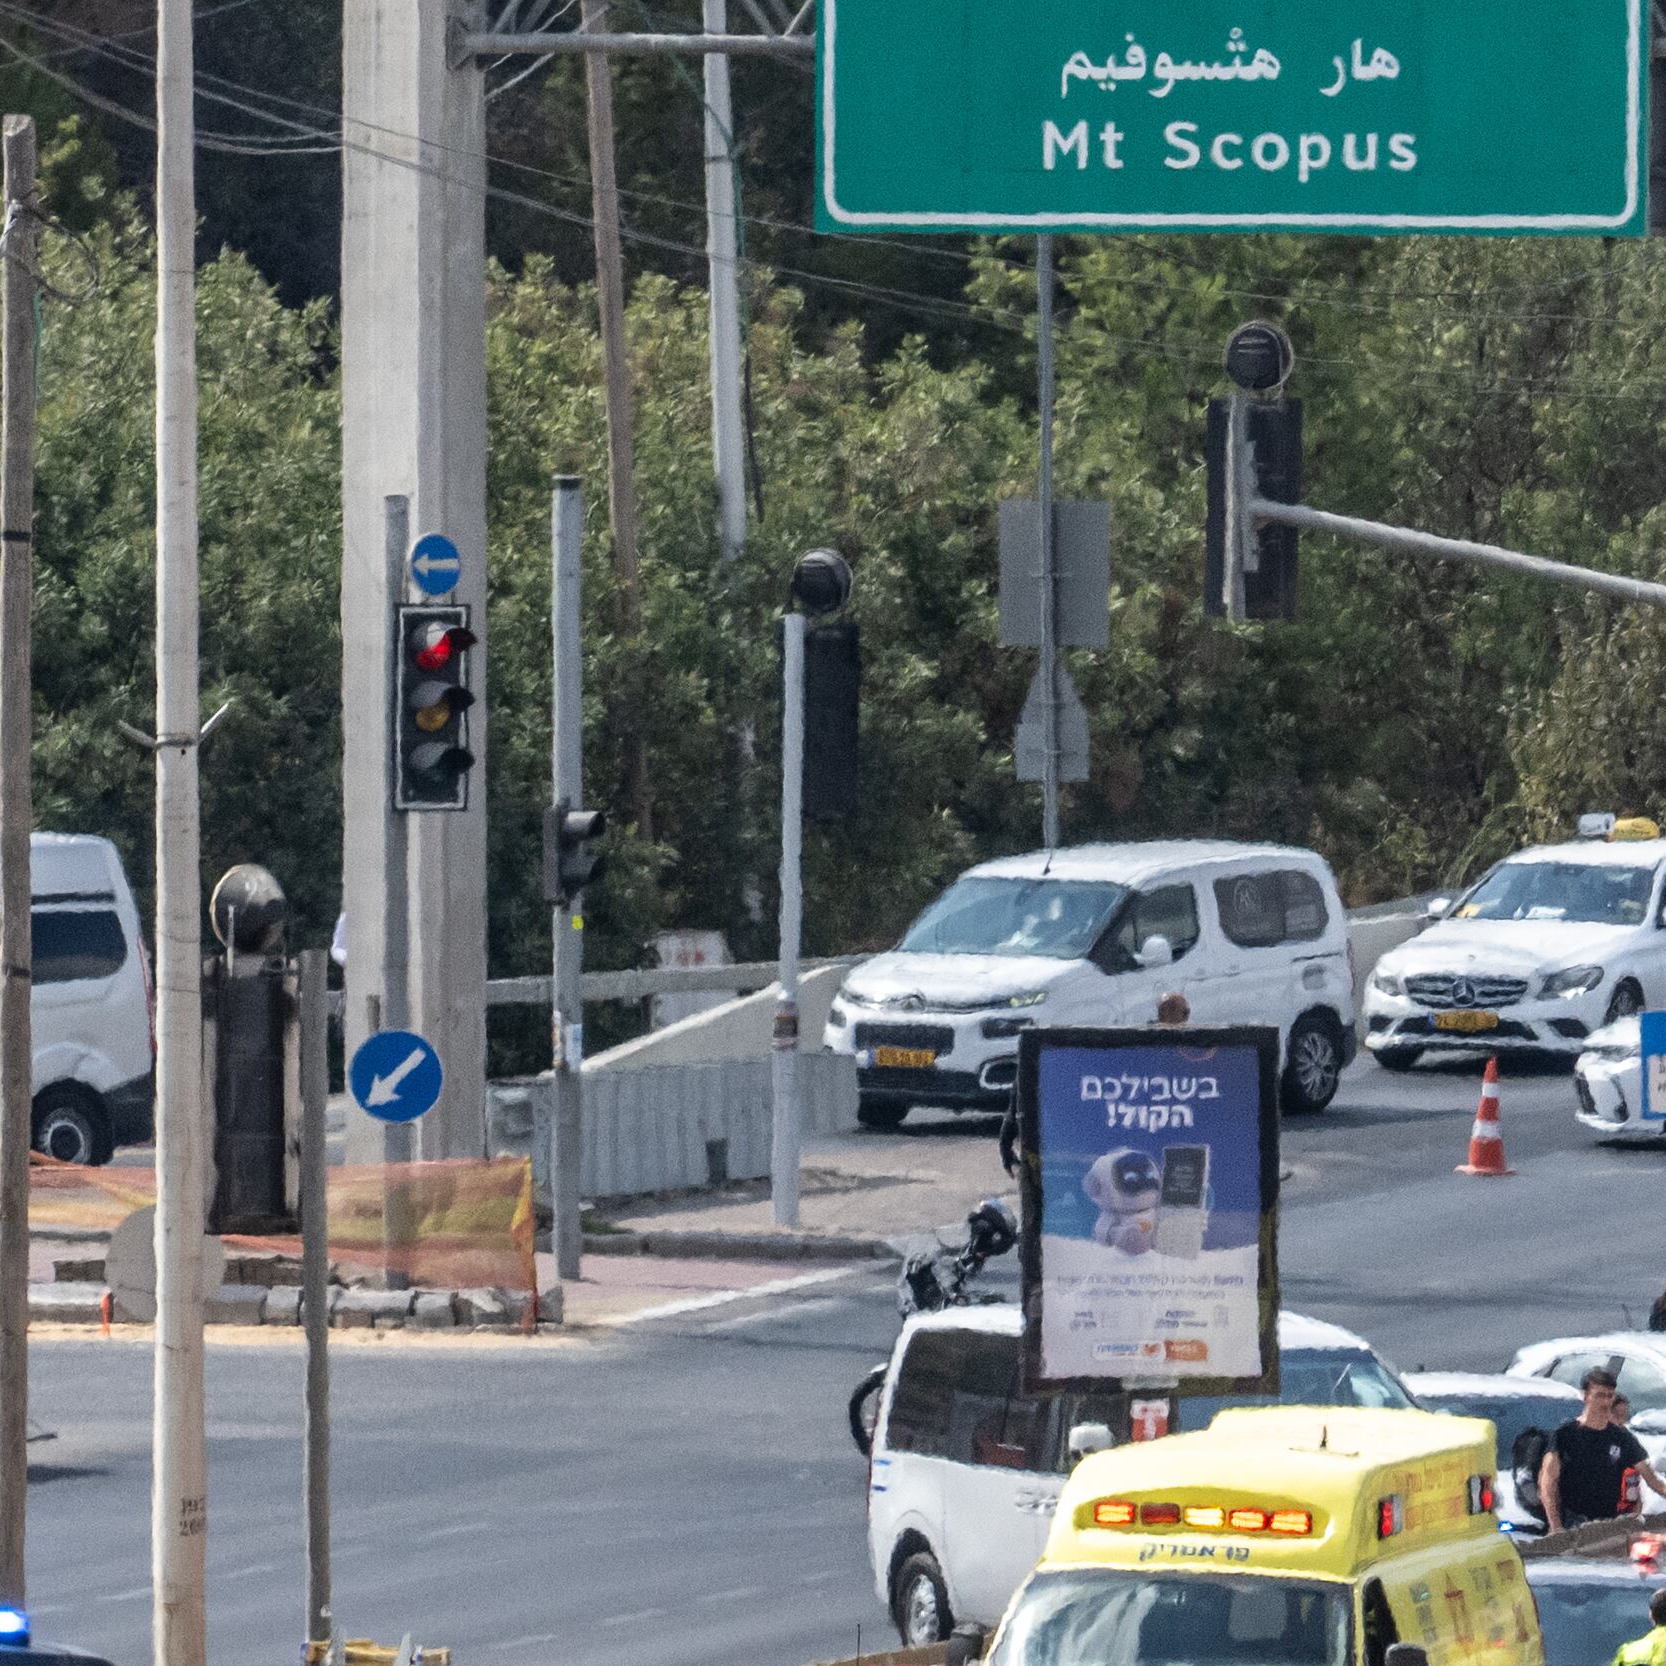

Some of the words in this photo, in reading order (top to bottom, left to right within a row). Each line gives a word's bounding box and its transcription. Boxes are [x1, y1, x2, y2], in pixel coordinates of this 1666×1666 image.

[1319, 38, 1401, 97] هار
[1042, 119, 1124, 171] Mt
[1163, 120, 1418, 184] Scopus
[1080, 1072, 1220, 1102] בשבילכם
